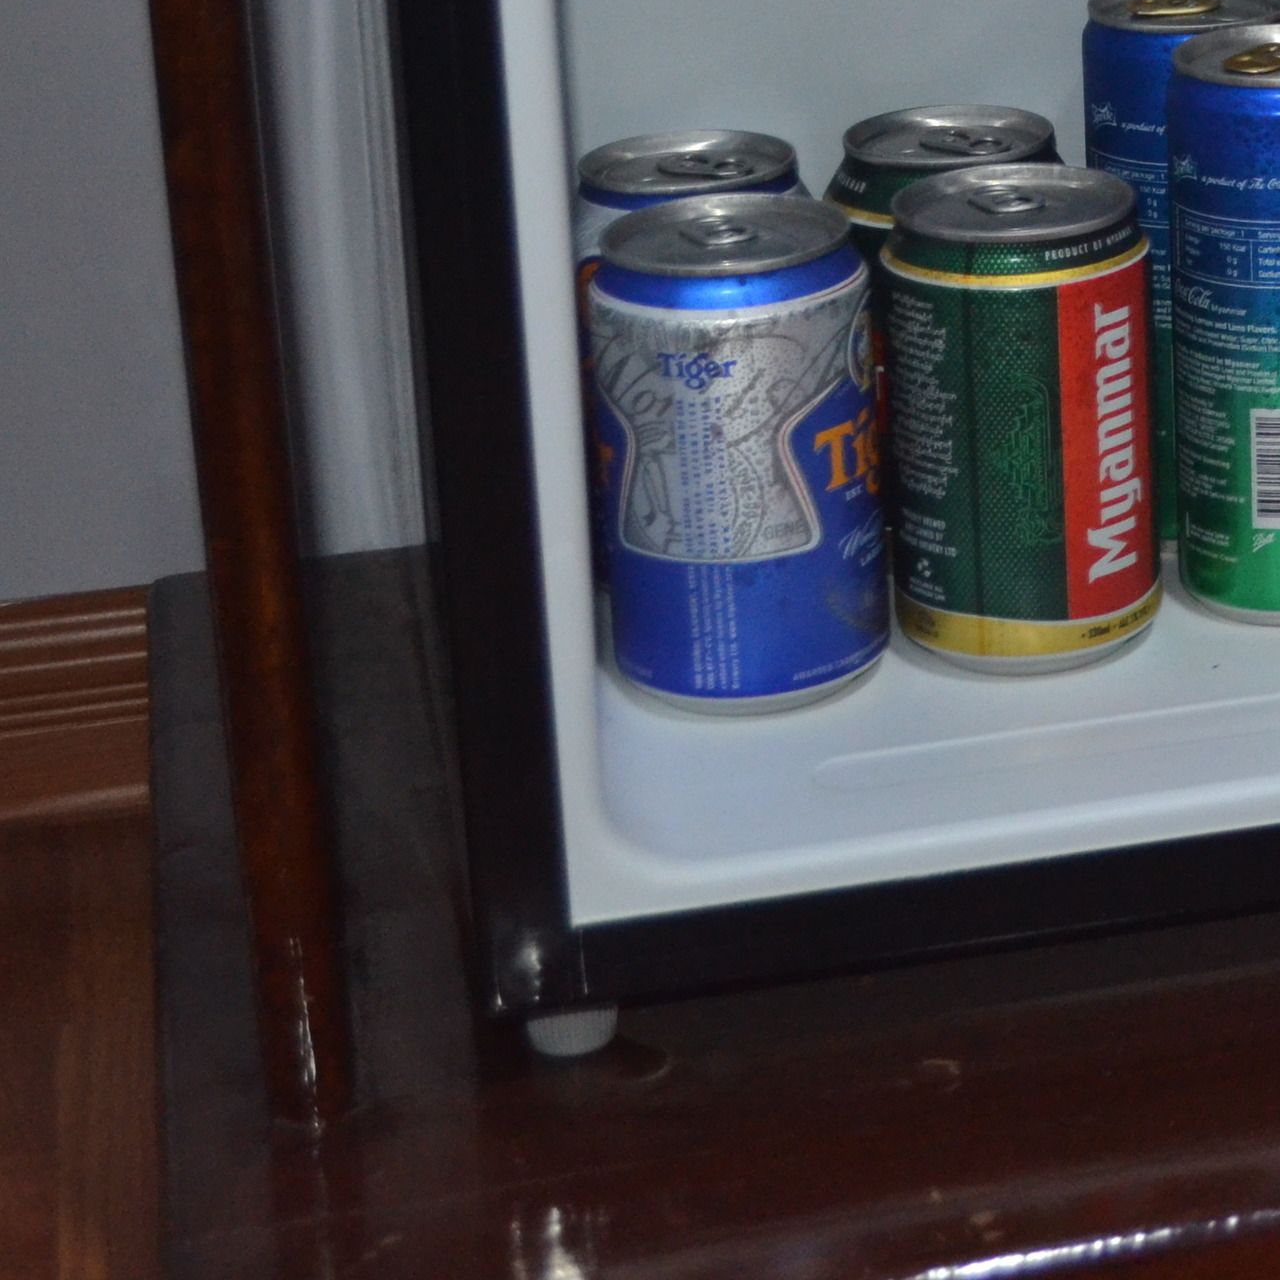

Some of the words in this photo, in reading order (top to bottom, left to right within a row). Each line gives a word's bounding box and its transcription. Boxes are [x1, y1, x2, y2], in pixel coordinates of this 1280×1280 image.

[1206, 176, 1235, 187] product
[1236, 179, 1248, 190] of
[1044, 242, 1089, 261] PRODUCT
[1092, 239, 1103, 251] OF
[1257, 257, 1274, 266] Total
[657, 352, 737, 390] Tiger
[1086, 302, 1142, 586] Myanmar
